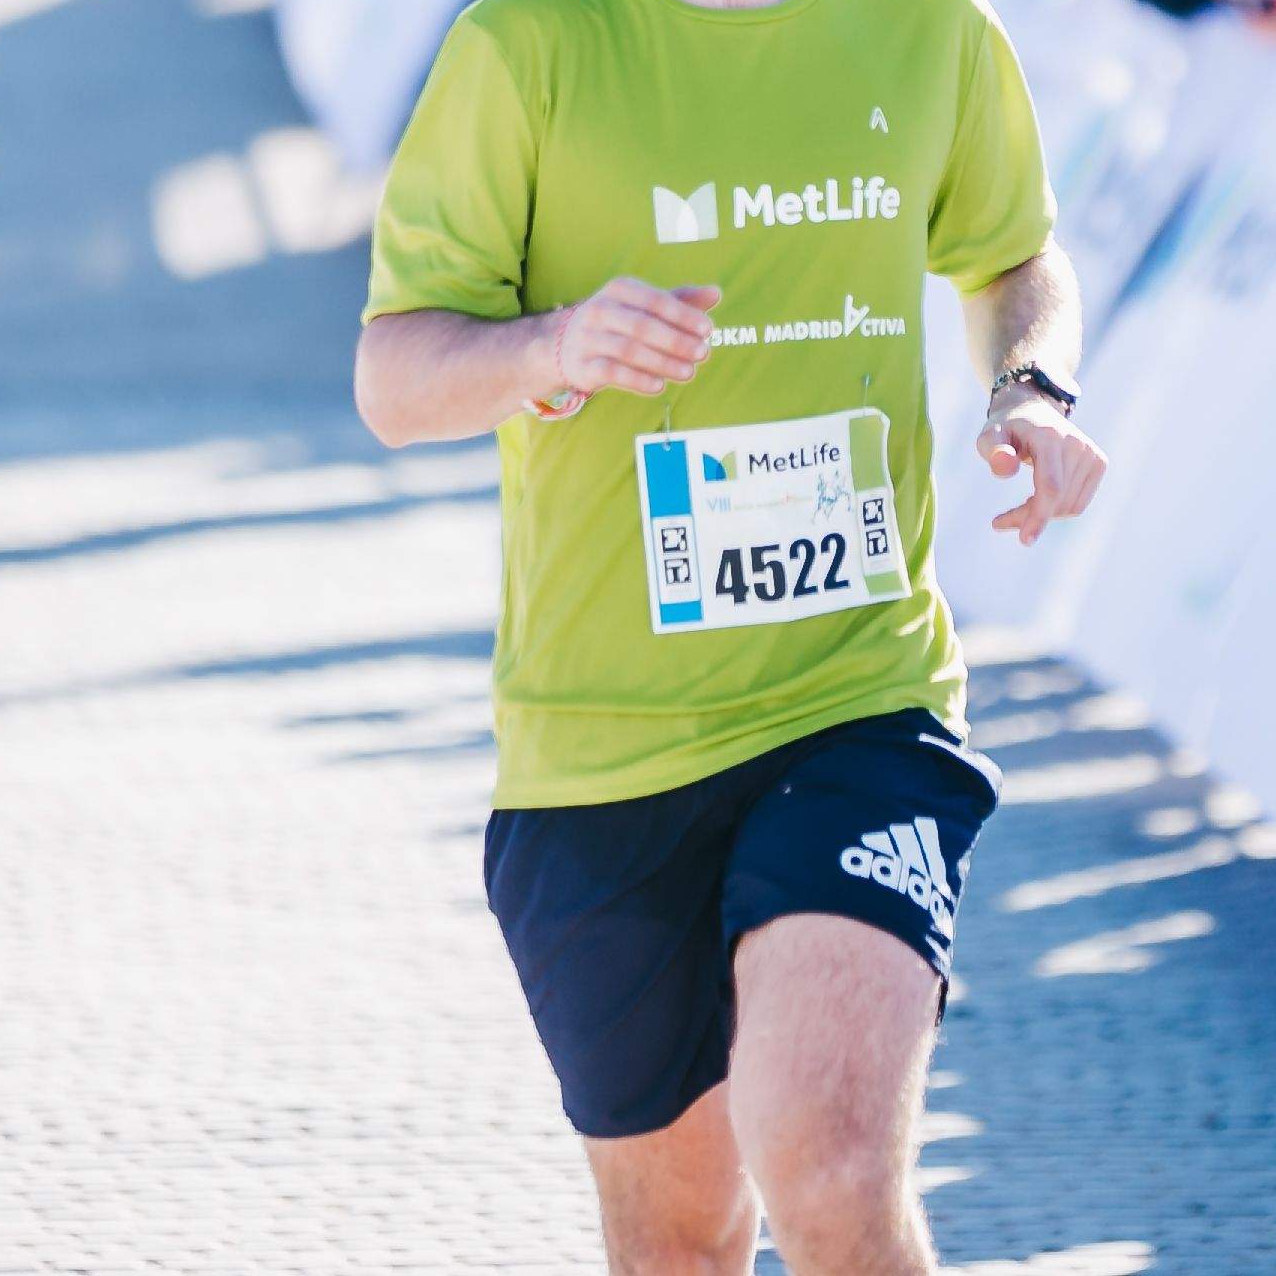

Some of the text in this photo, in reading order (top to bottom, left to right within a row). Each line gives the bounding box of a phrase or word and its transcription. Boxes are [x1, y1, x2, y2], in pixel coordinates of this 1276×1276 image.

[732, 176, 901, 229] MetLife
[748, 442, 841, 475] MetLife
[715, 532, 852, 606] 4522
